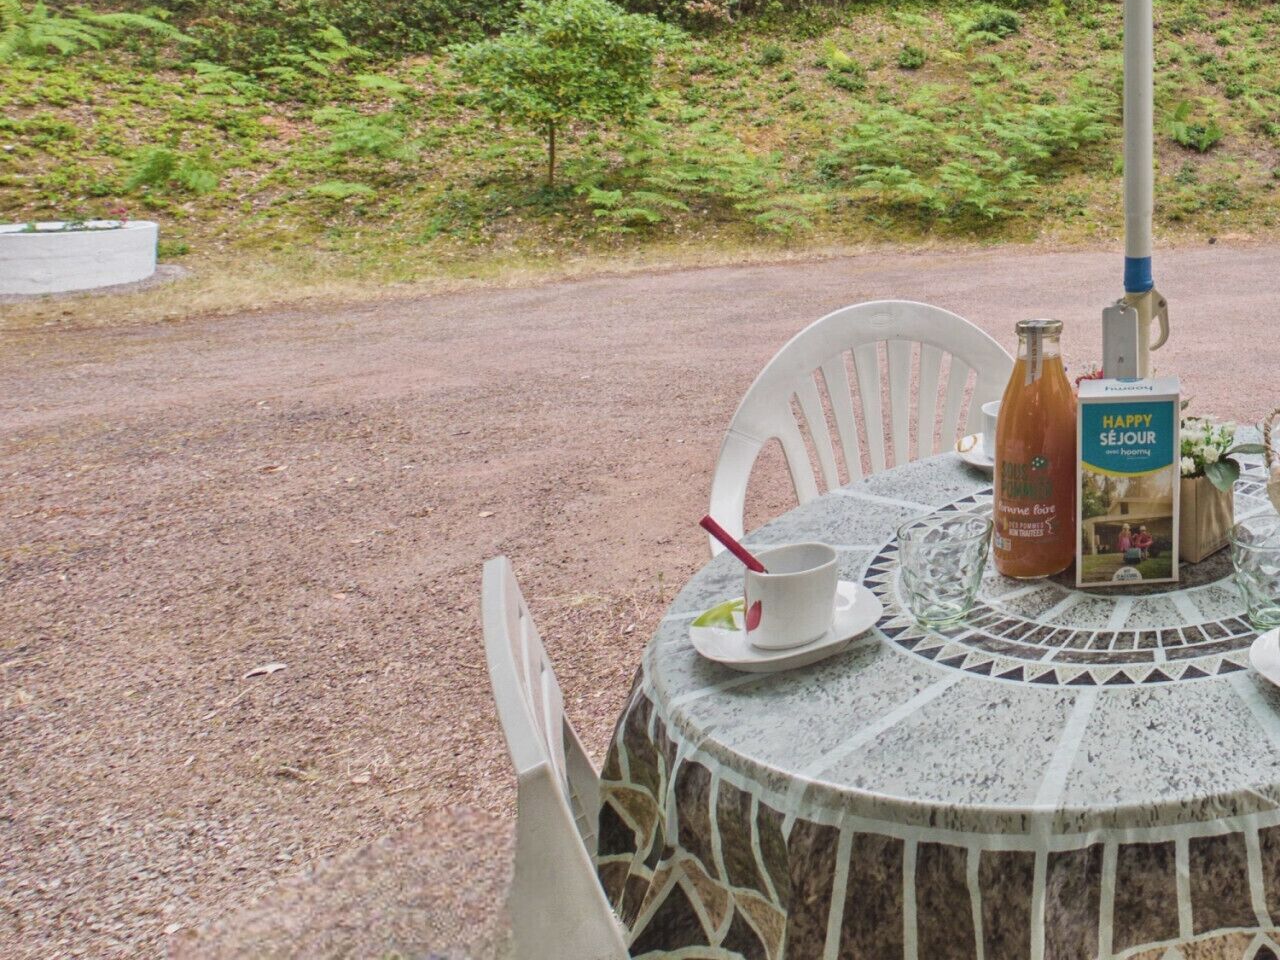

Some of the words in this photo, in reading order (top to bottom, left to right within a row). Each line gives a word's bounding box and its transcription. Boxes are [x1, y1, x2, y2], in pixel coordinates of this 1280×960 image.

[1103, 414, 1152, 428] HAPPY
[1100, 430, 1156, 445] SÉJOUR
[1120, 447, 1151, 456] hoomy
